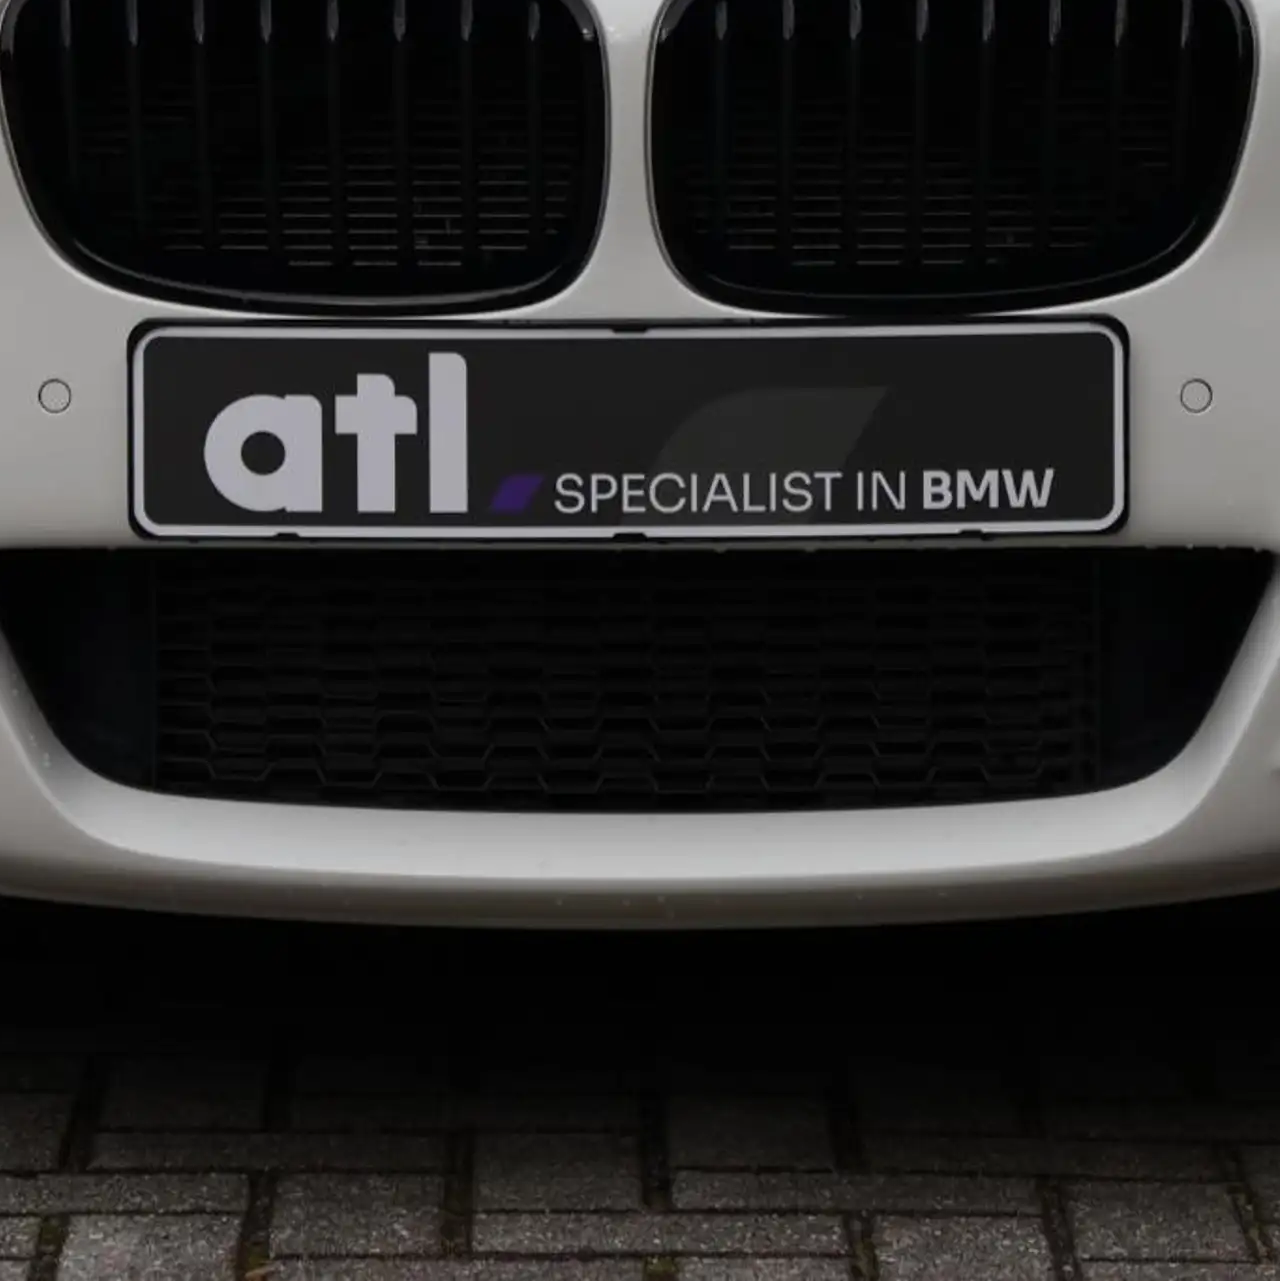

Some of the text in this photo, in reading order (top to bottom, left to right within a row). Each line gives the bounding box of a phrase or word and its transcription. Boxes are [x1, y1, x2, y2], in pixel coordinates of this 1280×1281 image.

[204, 353, 468, 513] atl
[555, 468, 1054, 514] SPECIALIST IN BMW
